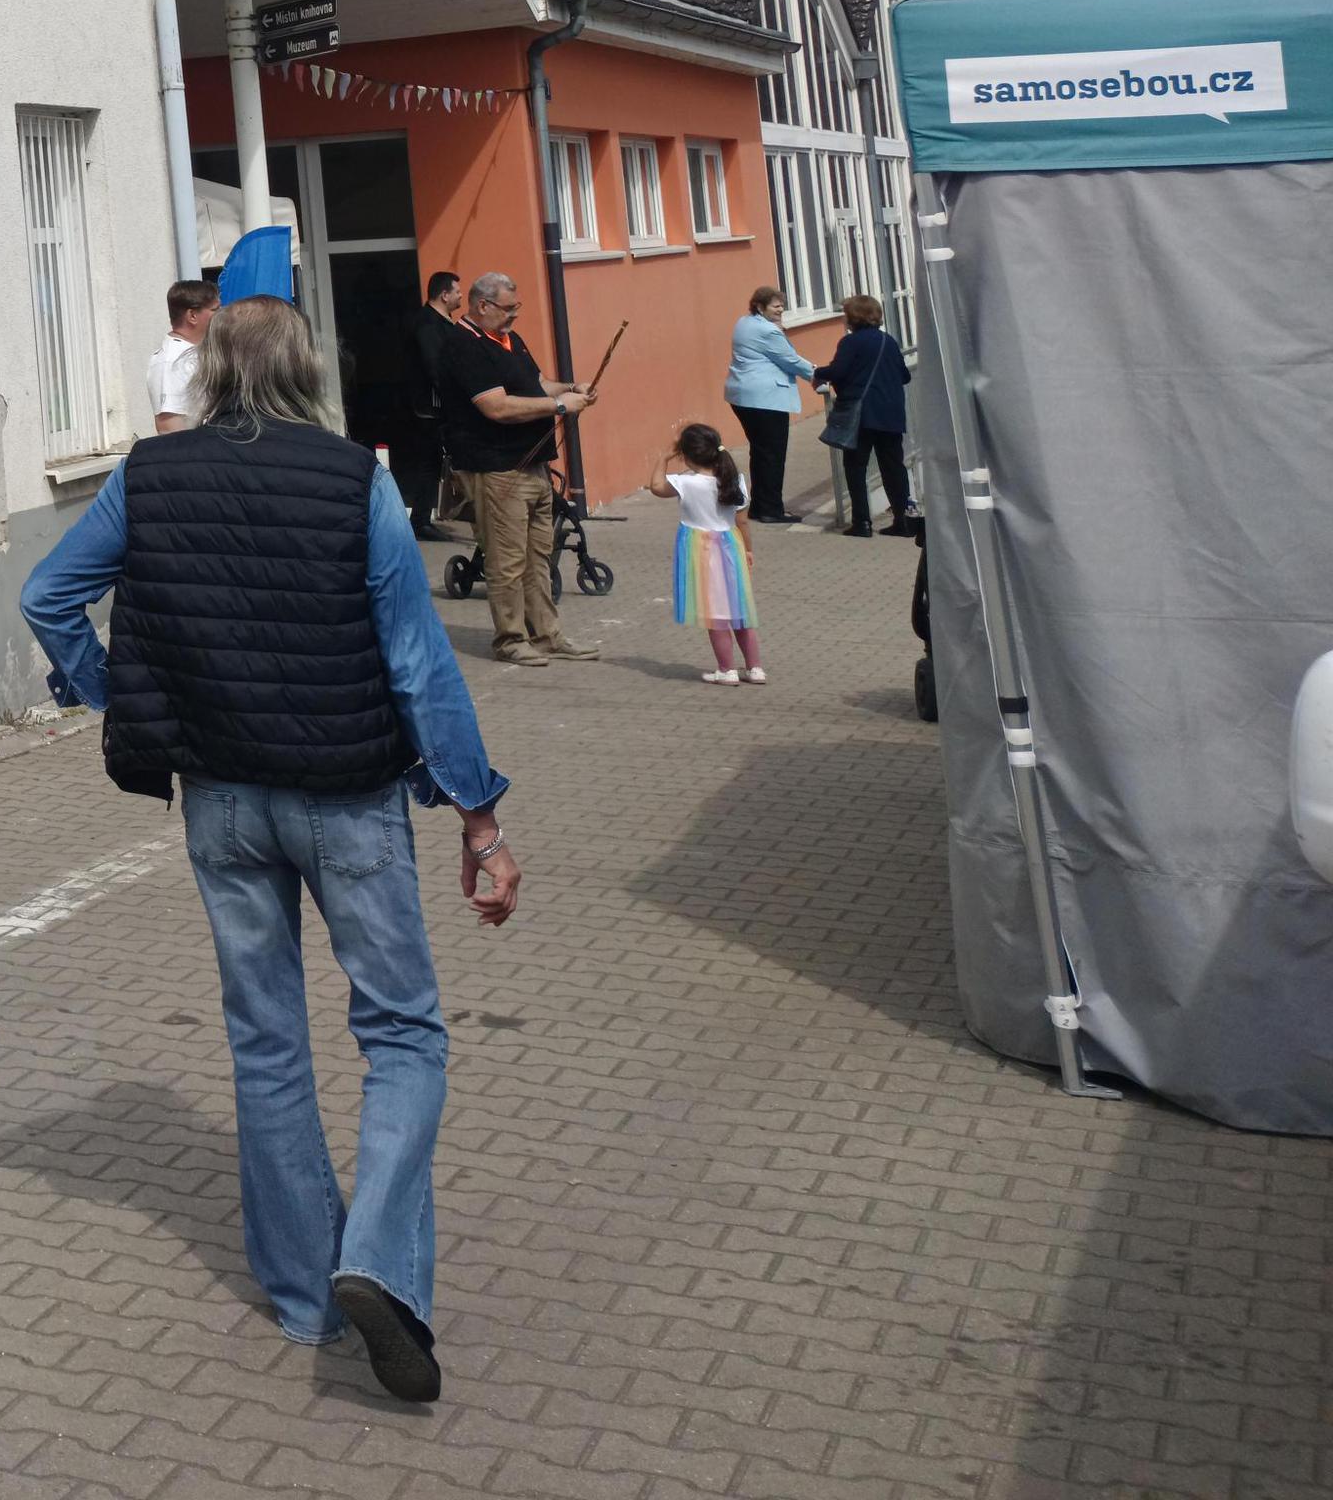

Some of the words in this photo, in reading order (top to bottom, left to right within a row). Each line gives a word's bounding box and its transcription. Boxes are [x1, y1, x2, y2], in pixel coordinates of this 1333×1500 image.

[300, 2, 333, 19] knihovna
[286, 39, 317, 54] Muzeum
[974, 70, 1254, 103] samosebou.cz
